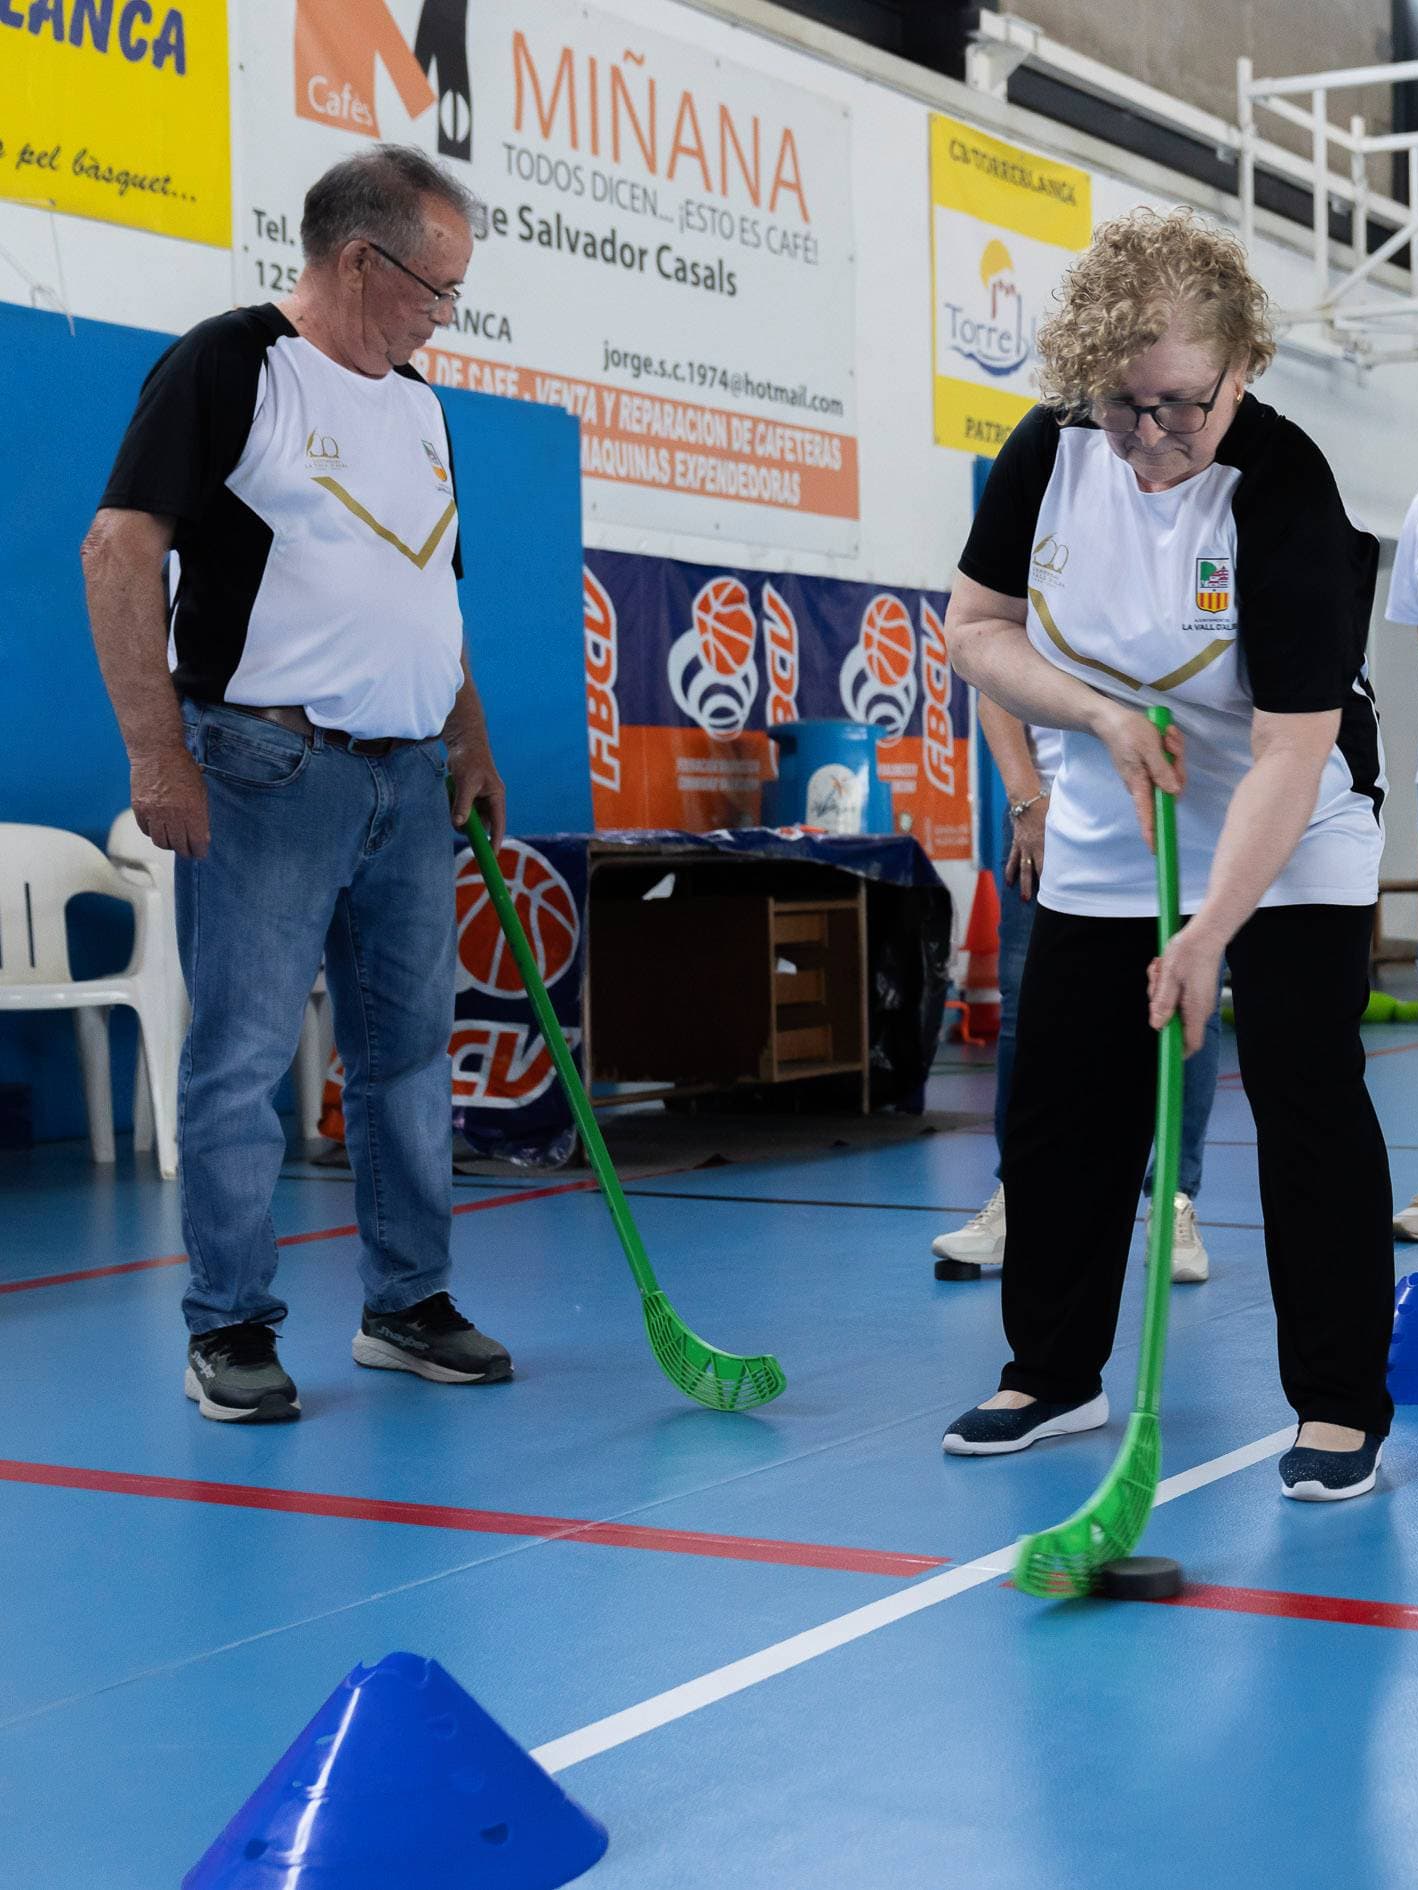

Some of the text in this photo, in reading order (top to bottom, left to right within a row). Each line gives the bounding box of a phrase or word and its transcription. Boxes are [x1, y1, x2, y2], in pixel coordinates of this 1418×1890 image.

[15, 143, 62, 171] pel
[512, 30, 810, 224] MIÑANA
[252, 207, 294, 245] Tel.
[503, 142, 819, 266] TODOS DICEN... ¡ESTO ES CAFÉ!
[518, 205, 648, 272] Salvador
[655, 245, 737, 297] Casals
[603, 340, 844, 417] jorge.s.c.1974@hotmail.com
[535, 376, 597, 425] VENTA
[602, 390, 617, 428] Y
[731, 417, 753, 453] DE
[754, 423, 842, 471] CAFETERAS
[674, 451, 801, 506] EXPENDEDORAS
